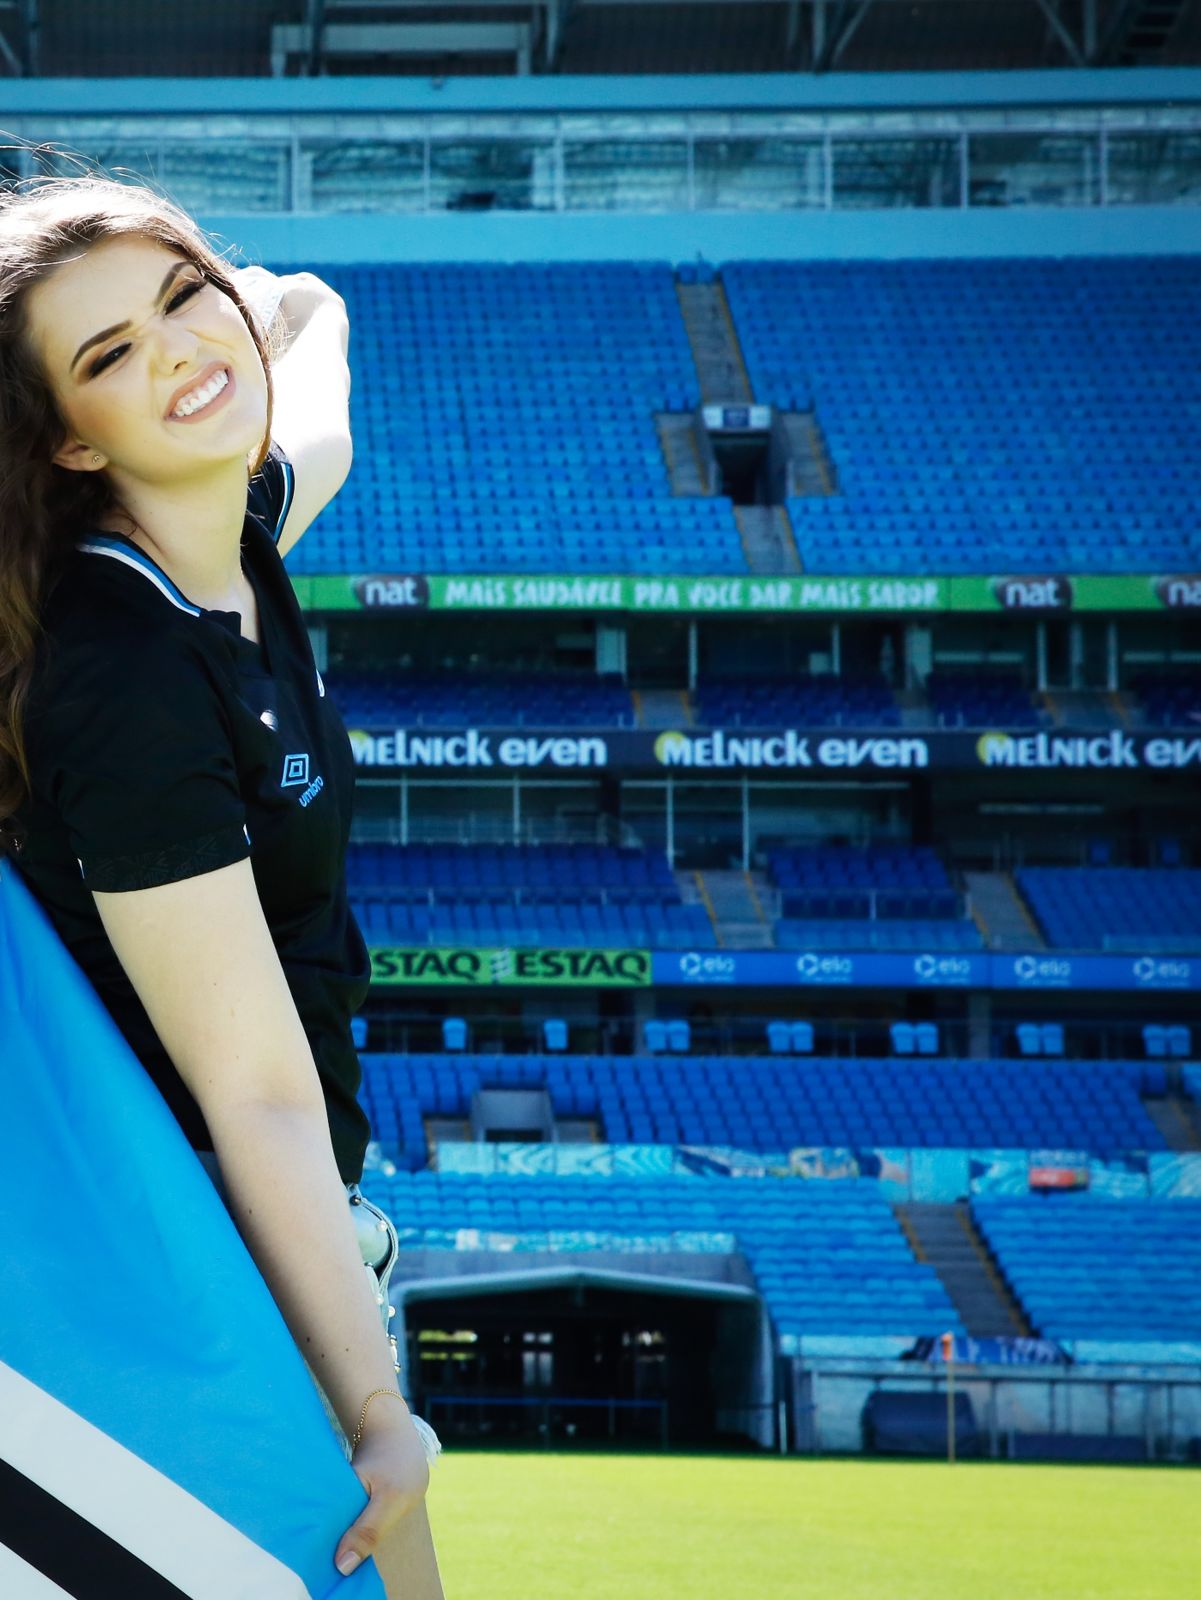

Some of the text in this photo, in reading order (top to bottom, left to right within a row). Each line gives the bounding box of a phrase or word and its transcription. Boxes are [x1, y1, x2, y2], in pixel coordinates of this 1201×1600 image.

[366, 577, 417, 606] nat
[1005, 579, 1061, 607] nat
[499, 737, 607, 767] even
[818, 737, 929, 767] even
[1144, 737, 1201, 767] ev
[299, 775, 324, 808] umbro
[375, 950, 648, 982] STAQ ESTAQ
